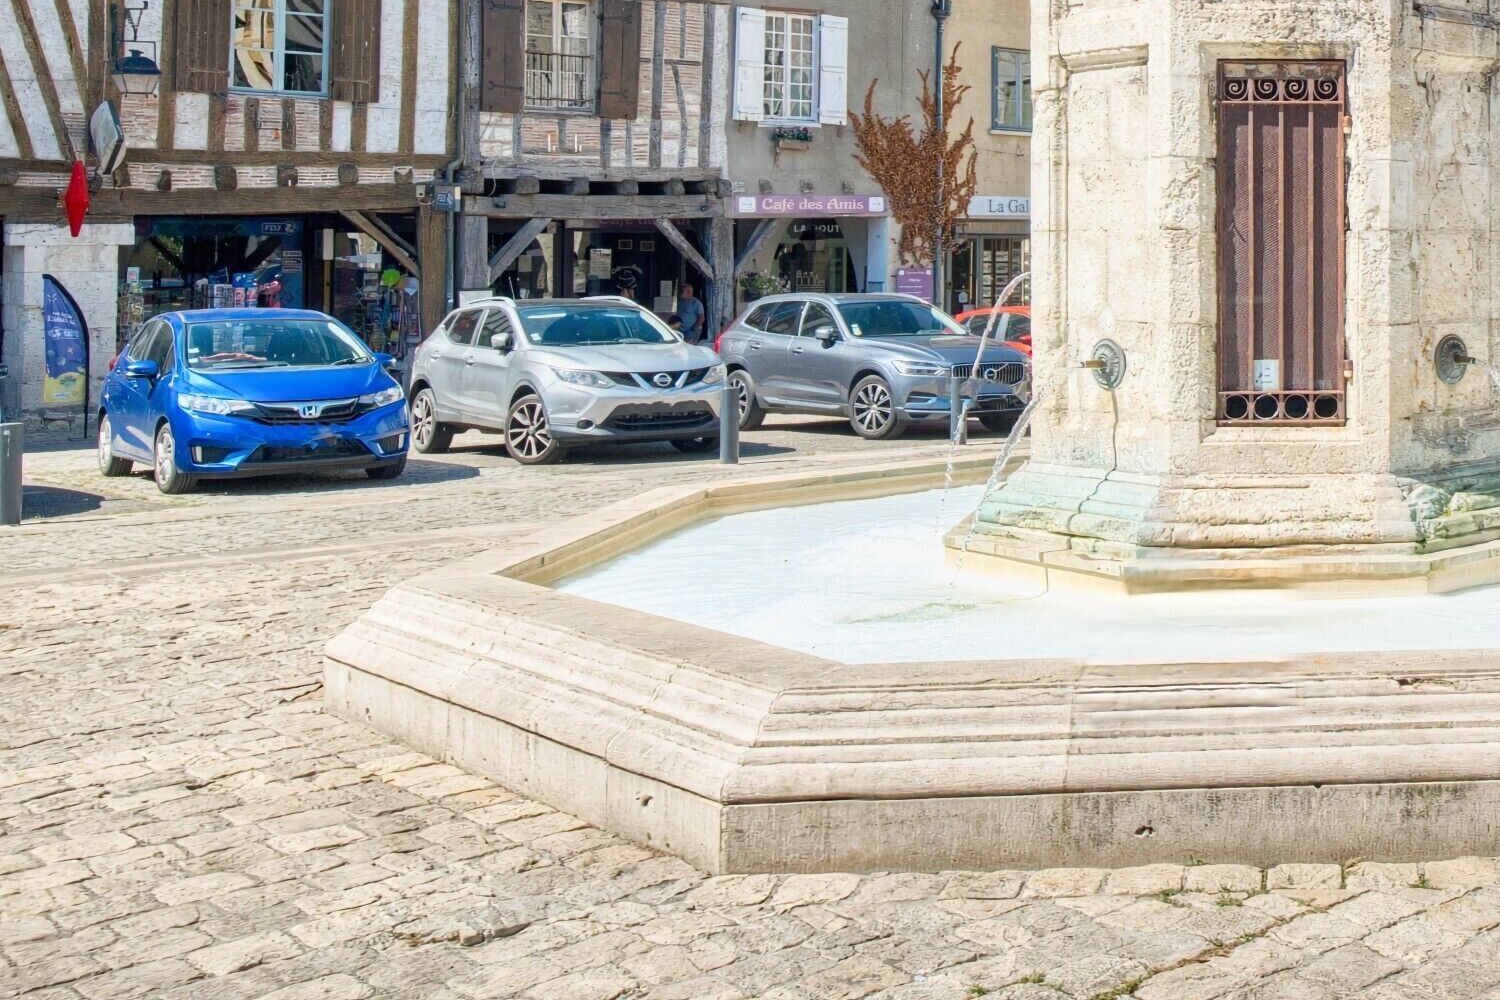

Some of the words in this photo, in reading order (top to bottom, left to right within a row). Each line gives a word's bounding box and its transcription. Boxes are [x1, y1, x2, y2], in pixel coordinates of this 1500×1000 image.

[762, 197, 795, 211] Café
[799, 198, 823, 210] des
[827, 198, 864, 210] Amis
[989, 199, 1004, 213] La
